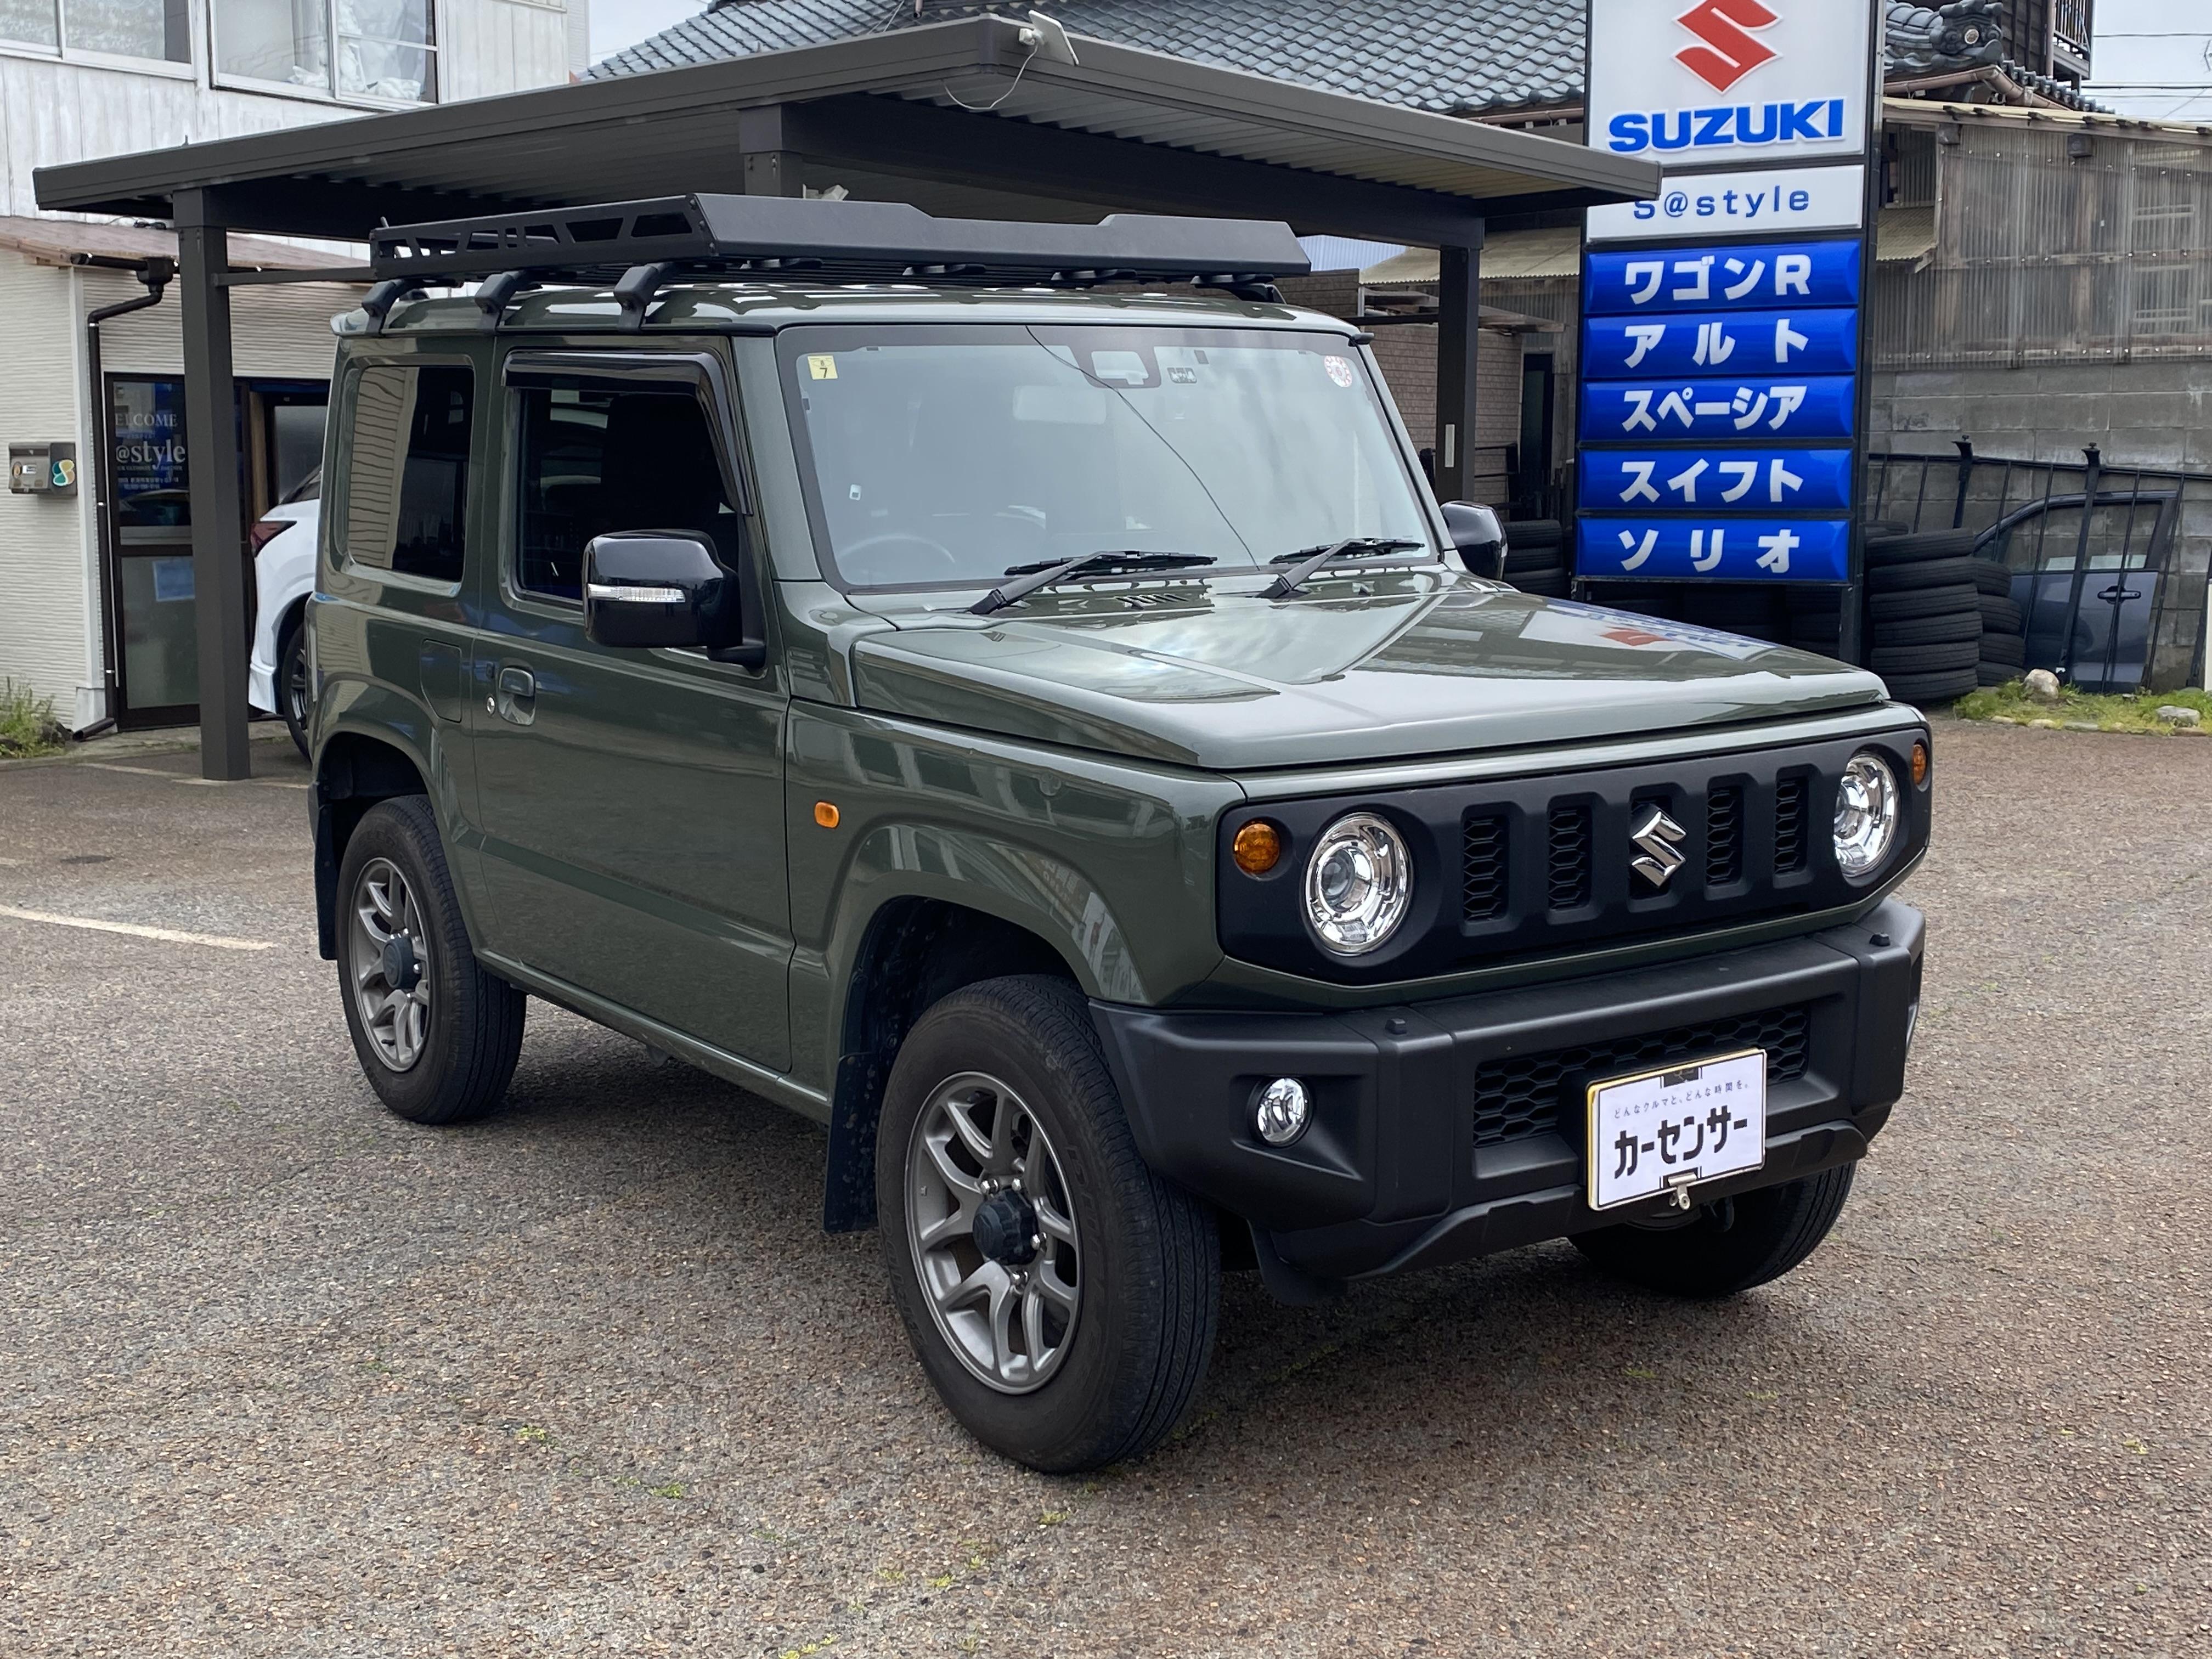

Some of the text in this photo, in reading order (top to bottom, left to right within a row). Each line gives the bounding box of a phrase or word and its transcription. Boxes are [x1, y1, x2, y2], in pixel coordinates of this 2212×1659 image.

[1609, 98, 1844, 153] SUZUKI
[1624, 254, 1811, 305] ワゴンR
[1623, 318, 1809, 369] アルト
[1621, 385, 1808, 432] スペーシア
[115, 438, 186, 471] @style
[1618, 458, 1804, 503] スイフト
[1617, 528, 1801, 574] ソリオ
[1614, 1104, 1747, 1180] カーセンサー
